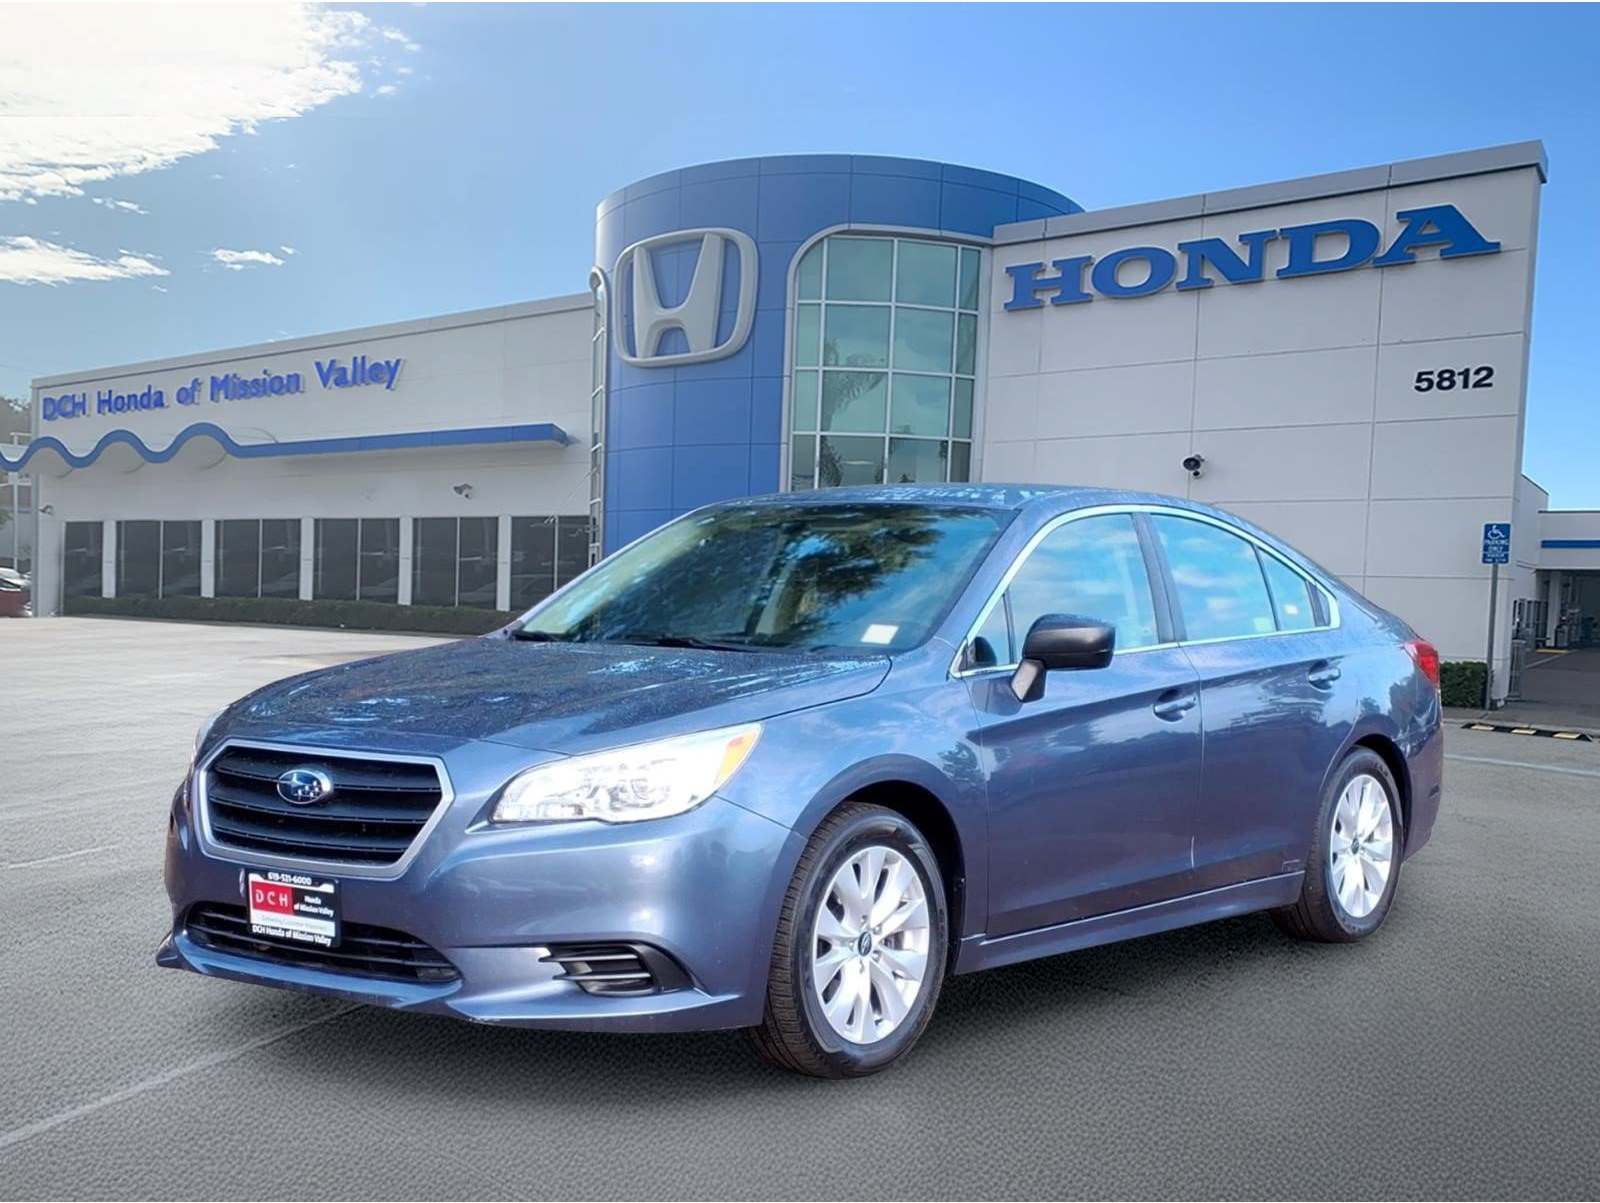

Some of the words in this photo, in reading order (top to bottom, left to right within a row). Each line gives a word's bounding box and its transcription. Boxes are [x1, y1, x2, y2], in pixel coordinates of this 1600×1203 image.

[1003, 203, 1503, 312] HONDA
[42, 391, 88, 421] DCH
[96, 384, 166, 416] Honda
[175, 377, 202, 406] of
[209, 368, 303, 402] Mission
[314, 354, 402, 391] Valley
[1414, 366, 1494, 393] 5812
[255, 889, 288, 907] DCH
[252, 924, 266, 934] DCH
[266, 926, 285, 937] Honda
